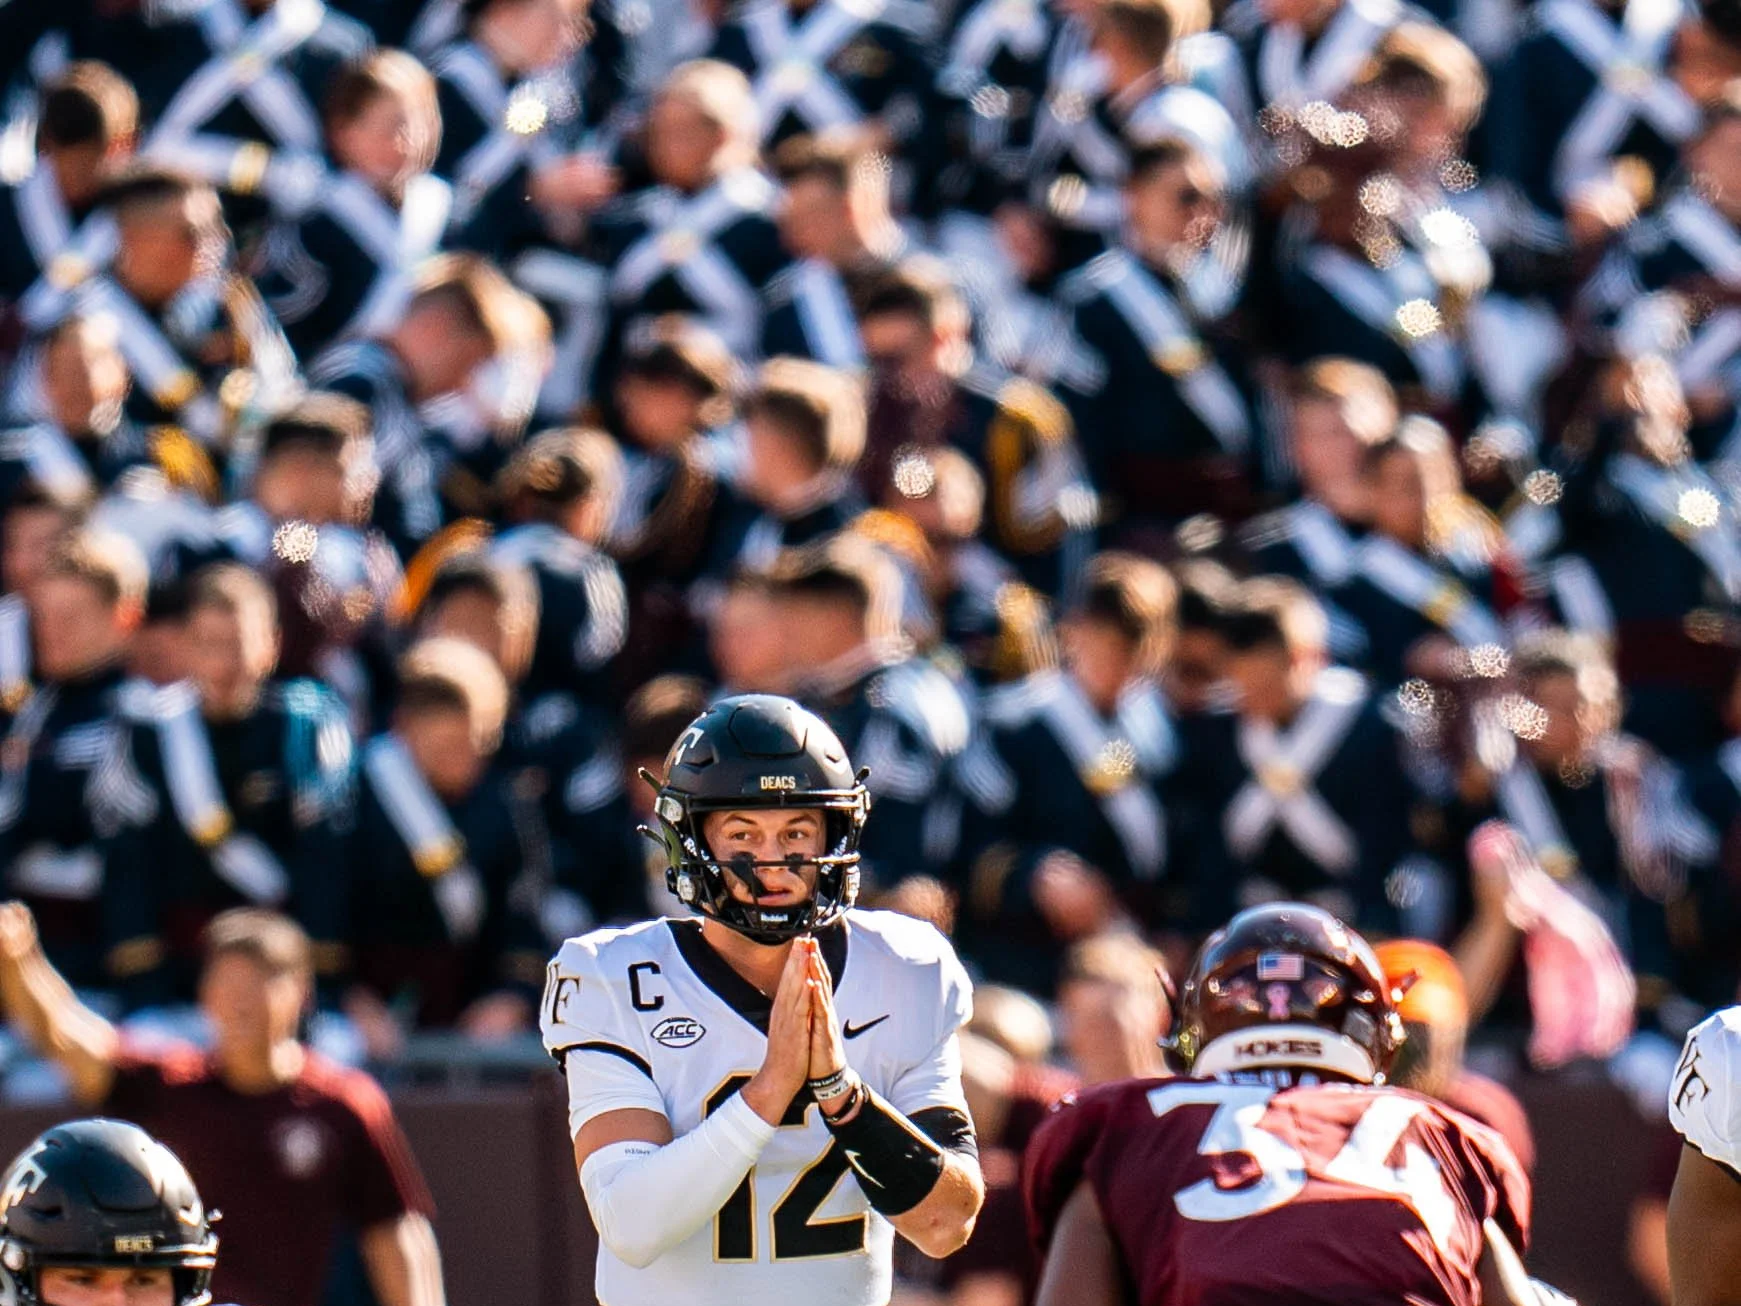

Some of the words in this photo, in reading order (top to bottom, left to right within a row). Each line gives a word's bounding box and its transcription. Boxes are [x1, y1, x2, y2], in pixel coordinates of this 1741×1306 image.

[760, 775, 796, 790] DEACS
[627, 961, 665, 1012] C
[659, 1023, 698, 1038] ACC
[1147, 1083, 1456, 1250] 34
